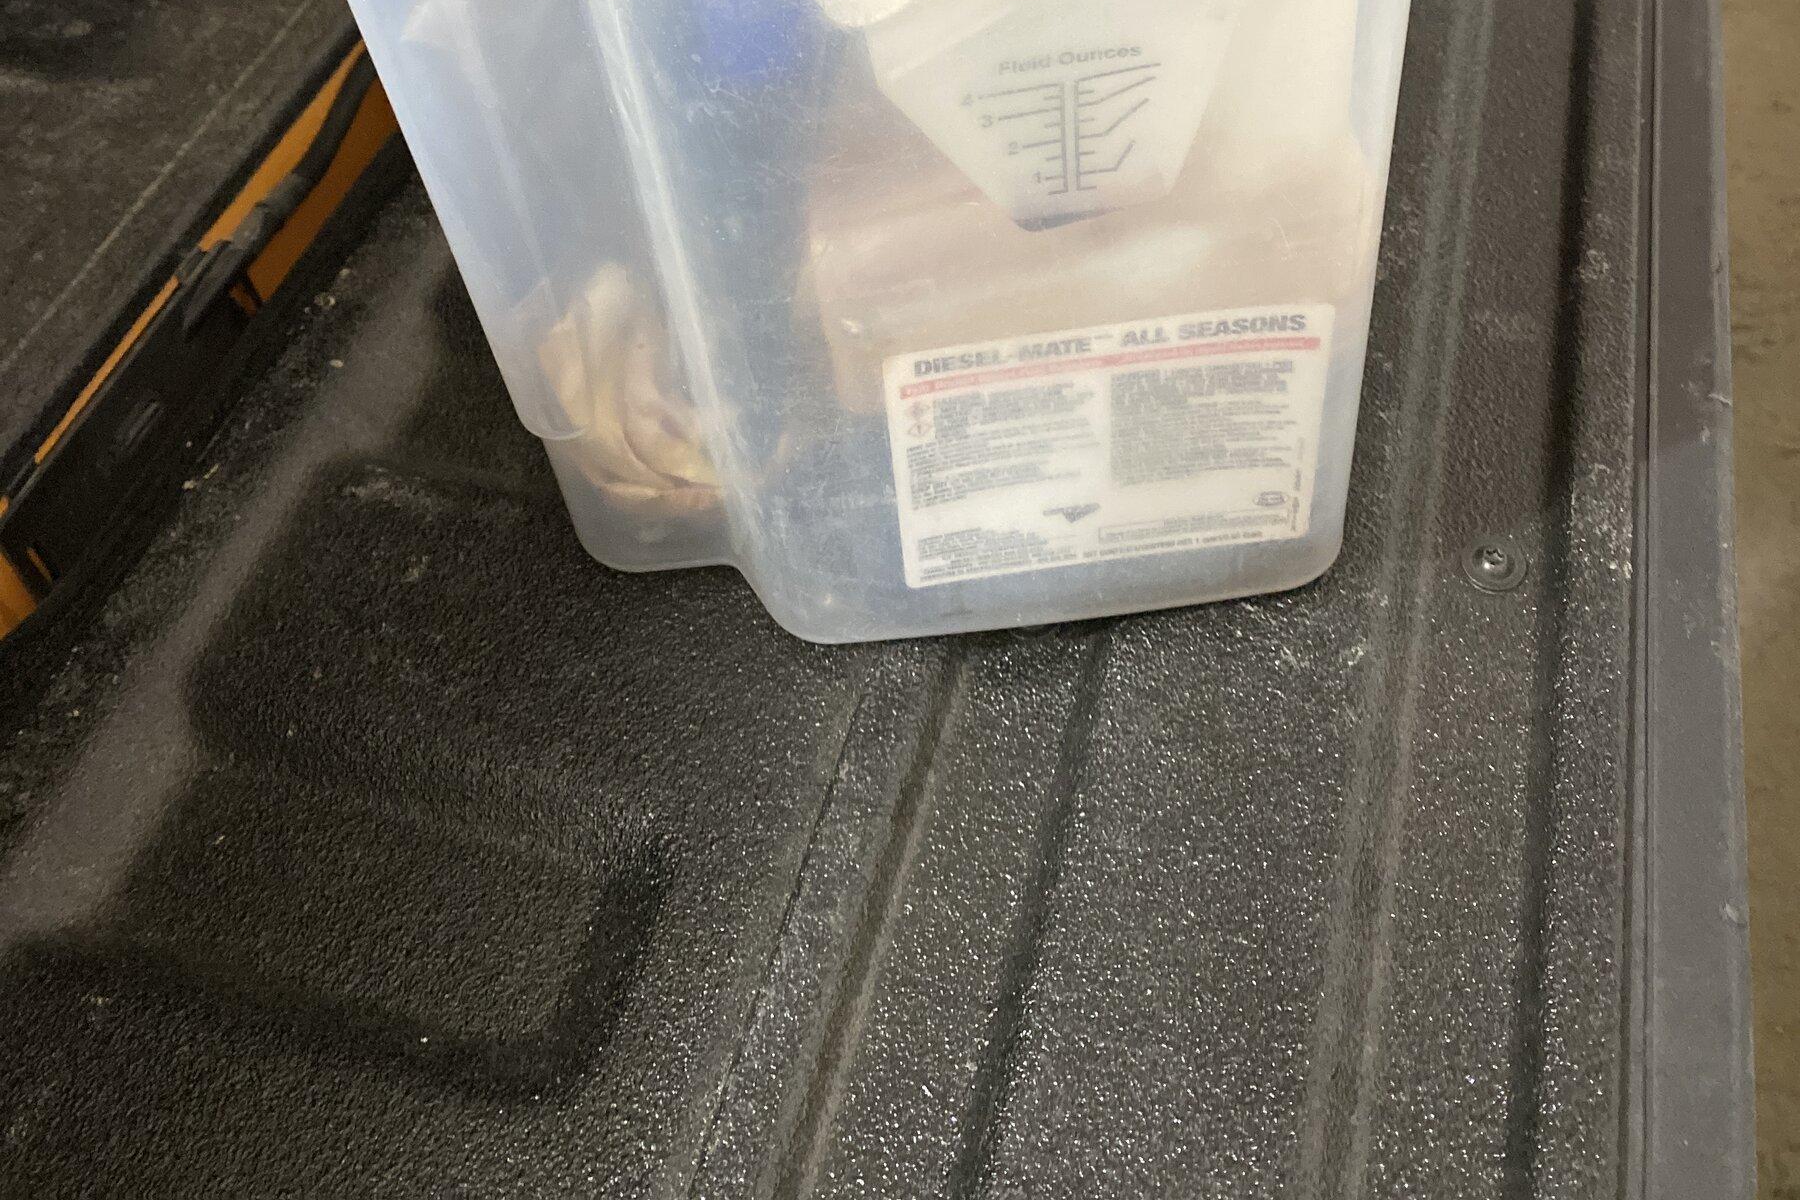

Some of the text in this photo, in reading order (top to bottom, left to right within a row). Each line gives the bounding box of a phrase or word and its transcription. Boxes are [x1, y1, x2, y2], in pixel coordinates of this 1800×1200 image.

[998, 45, 1143, 76] Fluid Ounces
[982, 114, 994, 129] 3
[1120, 326, 1170, 347] ALL
[1177, 313, 1307, 340] SEASONS
